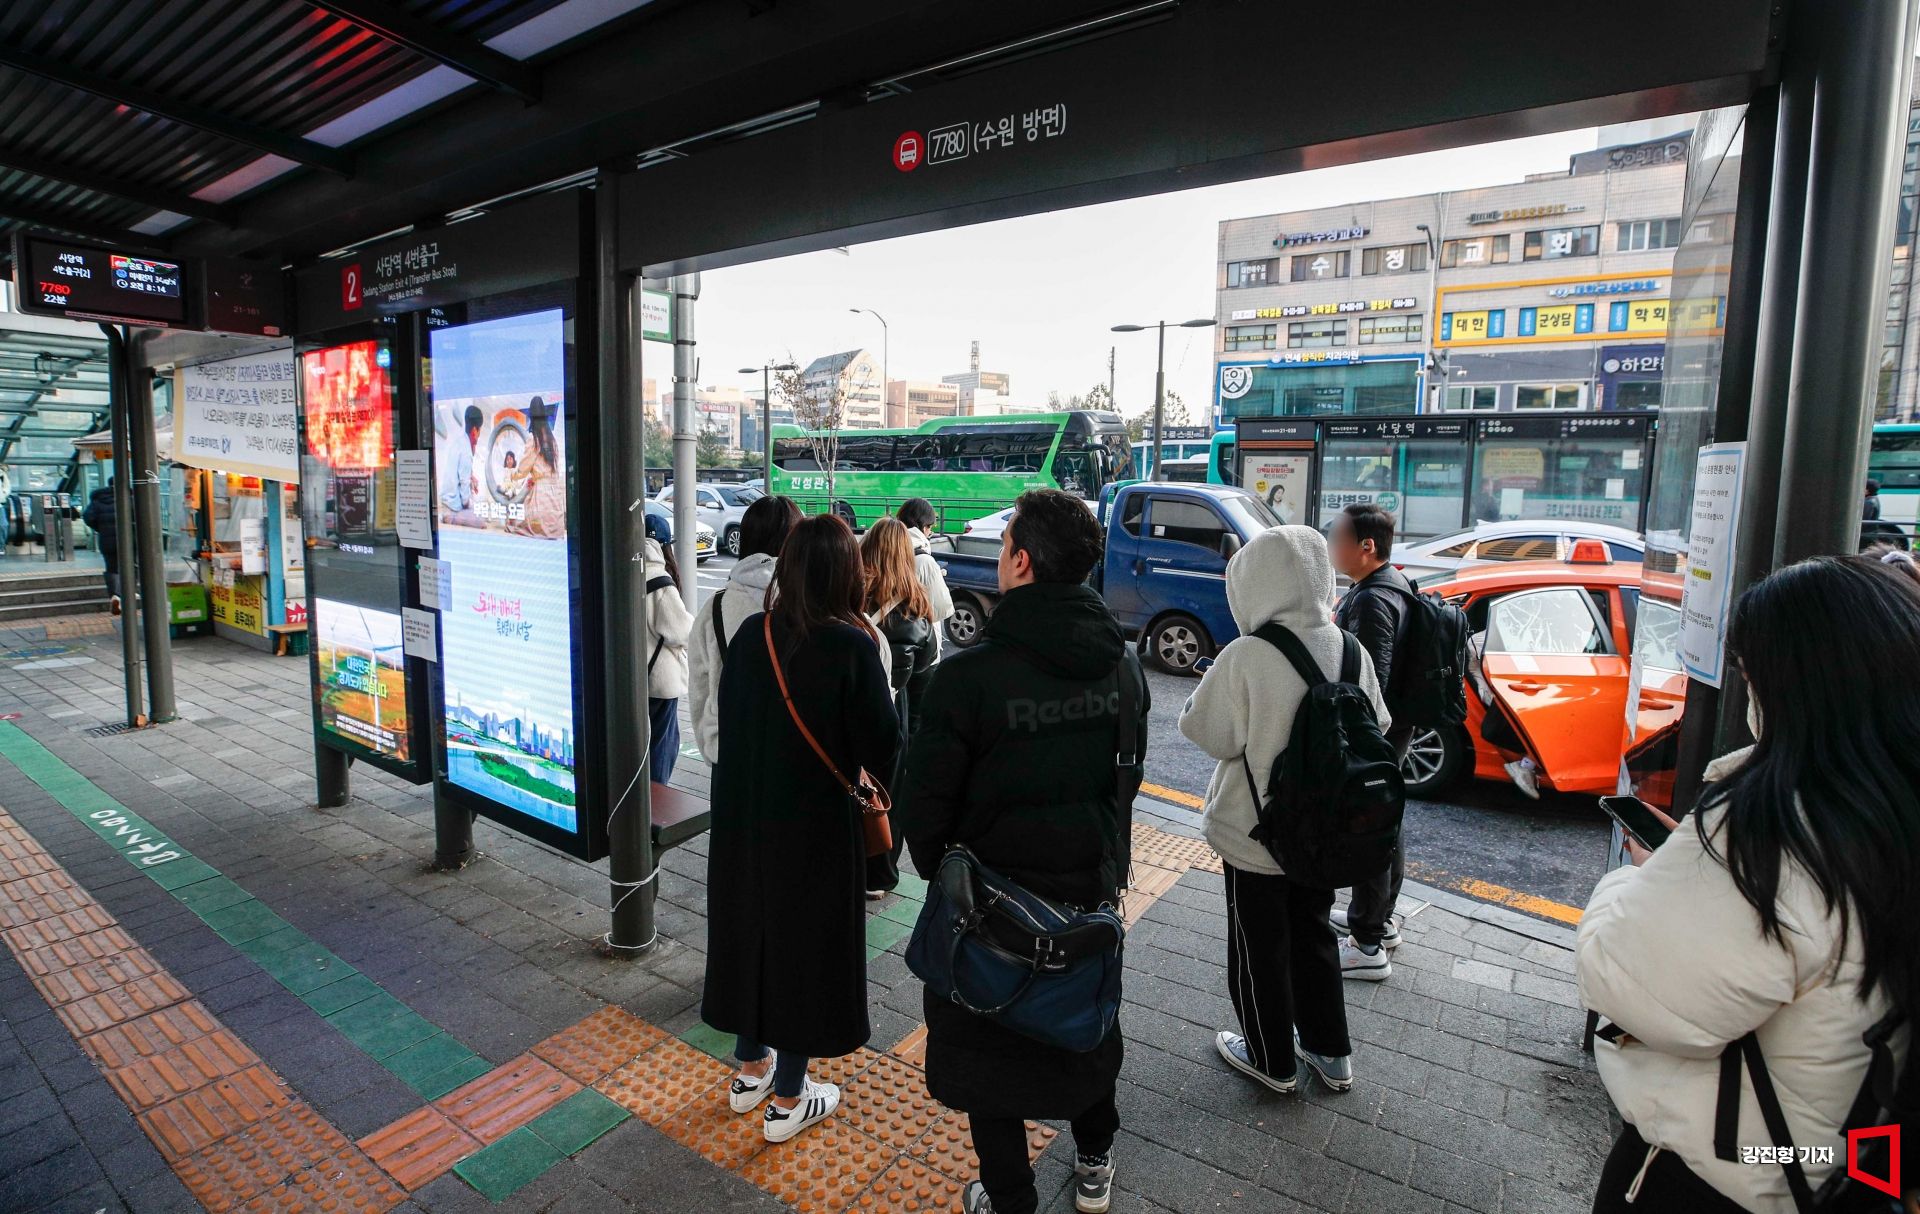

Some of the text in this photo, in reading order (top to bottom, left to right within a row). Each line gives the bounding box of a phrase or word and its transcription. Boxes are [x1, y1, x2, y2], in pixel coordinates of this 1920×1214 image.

[932, 103, 1067, 158] 7780 (수원 방면)
[58, 253, 83, 265] 사당역
[375, 242, 440, 278] 사당역 4번출구
[1311, 232, 1573, 276] 수 정 교 회
[39, 281, 71, 295] 7780
[145, 284, 167, 293] 8:14
[347, 271, 357, 303] 2
[362, 286, 379, 298] Sadang
[379, 281, 395, 295] Station
[404, 277, 409, 286] 4
[432, 268, 442, 280] Bus
[43, 293, 67, 305] 22분
[1456, 317, 1484, 332] 대한
[1539, 312, 1572, 328] 군상담
[1634, 307, 1666, 322] 학회
[1376, 423, 1415, 434] 사당역
[1724, 464, 1737, 475] 안내
[516, 620, 533, 642] 서울
[1005, 688, 1120, 733] Reebo
